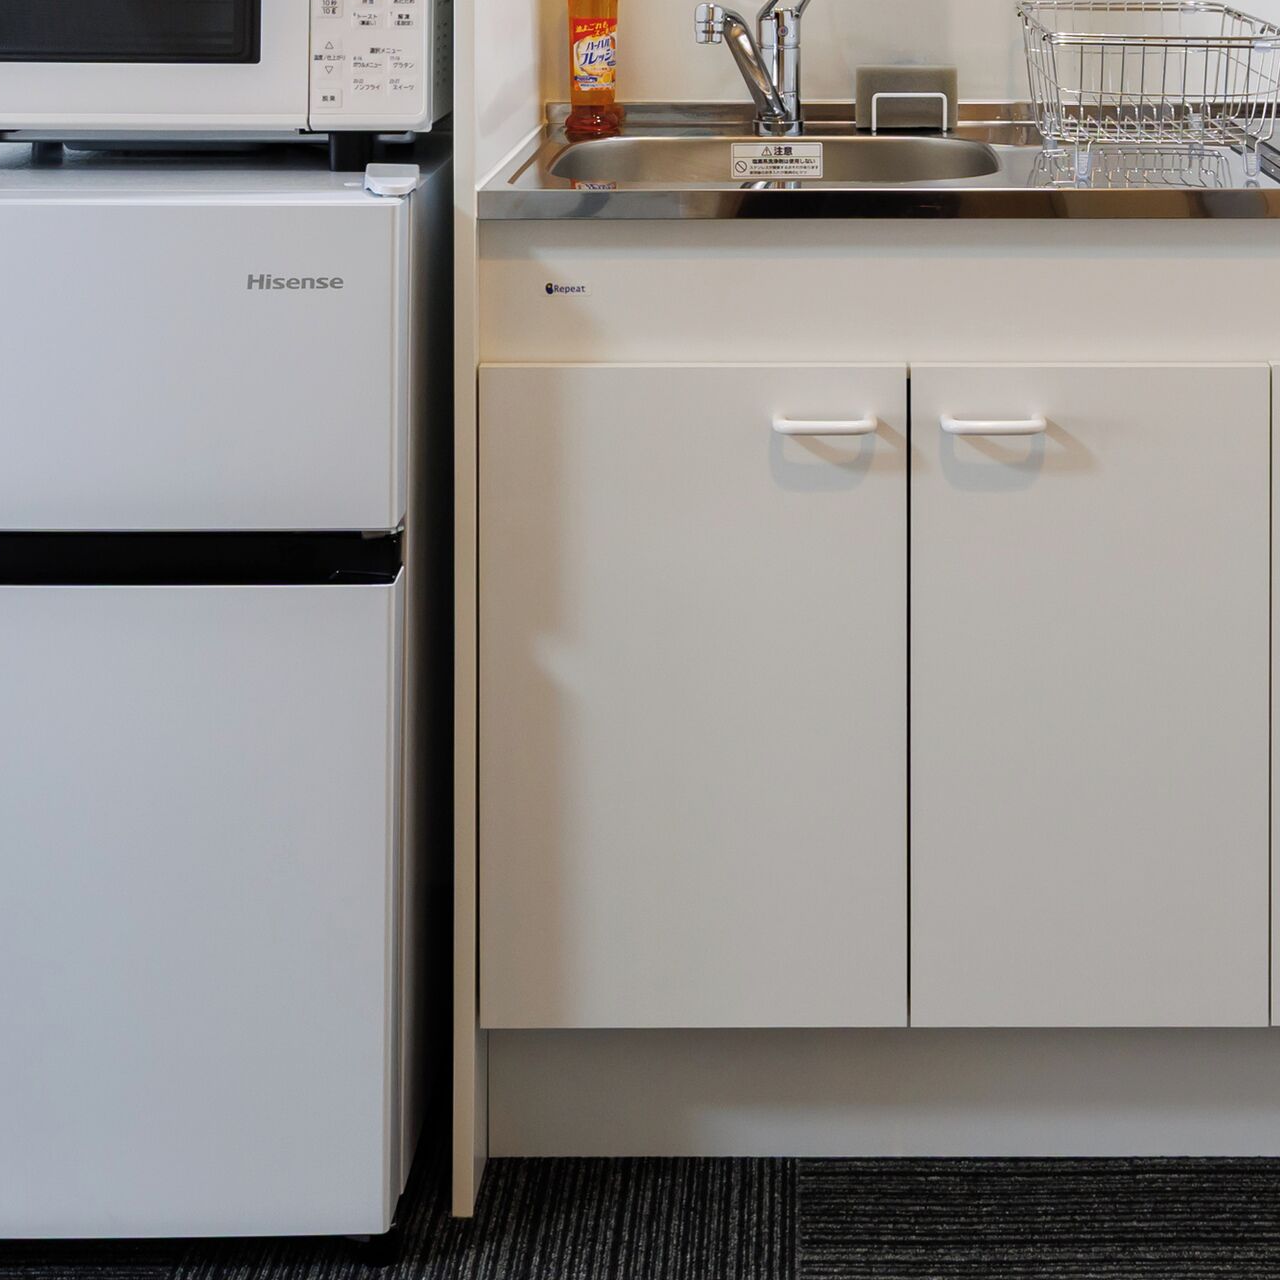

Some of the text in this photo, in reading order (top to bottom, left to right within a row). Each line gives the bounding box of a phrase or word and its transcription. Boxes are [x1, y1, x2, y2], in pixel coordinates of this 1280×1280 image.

[773, 146, 793, 156] 注意
[247, 274, 344, 290] Hisense
[554, 285, 586, 293] Repeat
